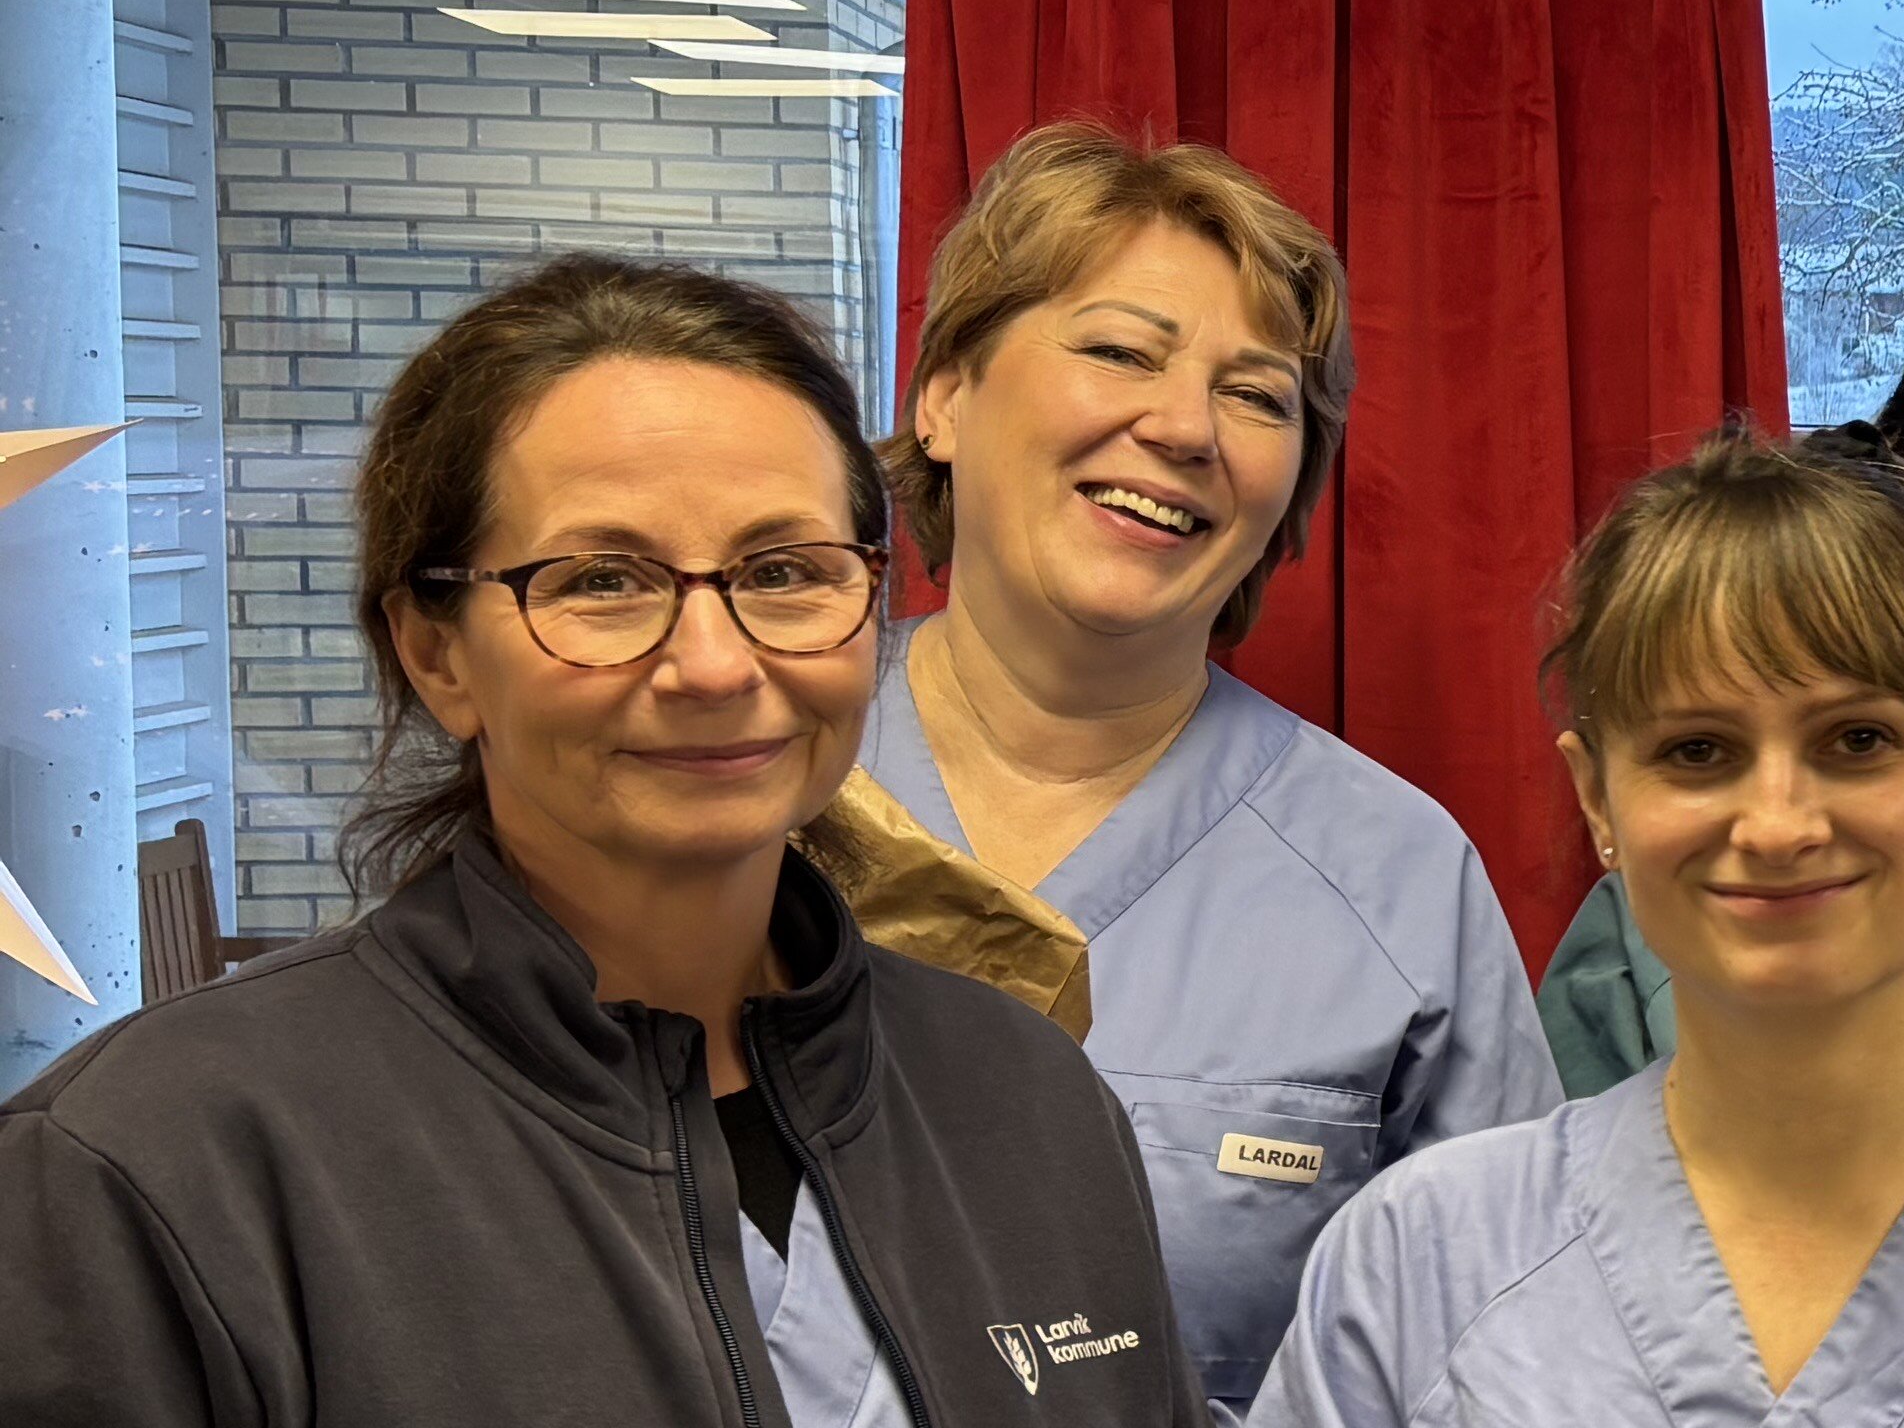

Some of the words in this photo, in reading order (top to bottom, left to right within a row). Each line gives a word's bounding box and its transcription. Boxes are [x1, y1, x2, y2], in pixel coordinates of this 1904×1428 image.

[1238, 1144, 1319, 1171] LARDAL
[1034, 1312, 1092, 1344] Larvik
[1046, 1330, 1140, 1365] kommune
